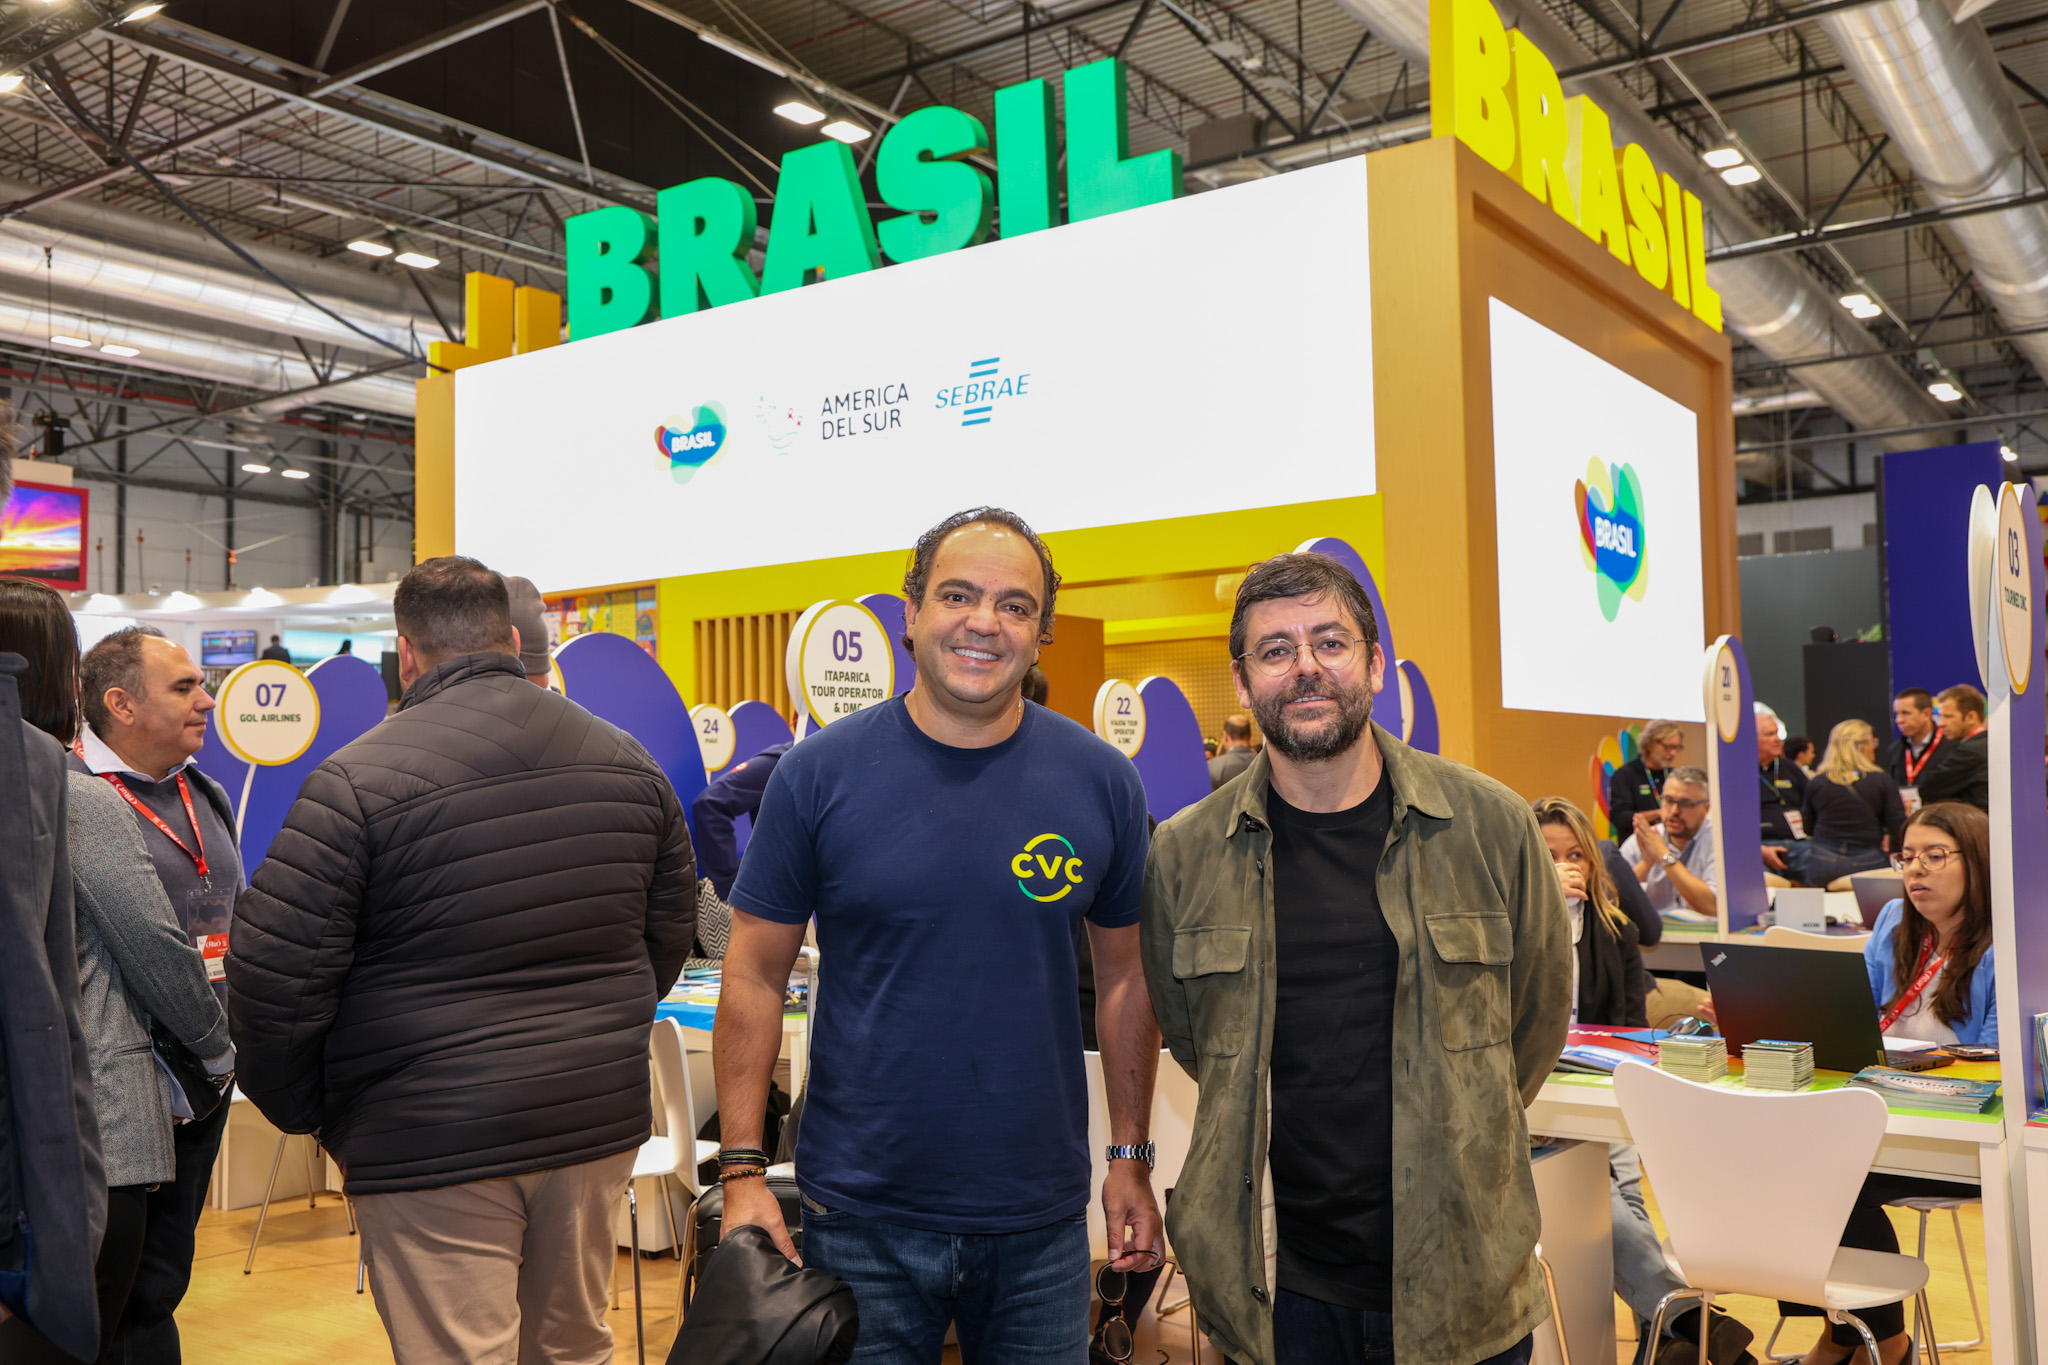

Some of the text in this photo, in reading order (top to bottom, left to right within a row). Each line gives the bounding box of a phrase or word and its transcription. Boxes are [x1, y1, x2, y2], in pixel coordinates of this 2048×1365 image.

[1430, 0, 1723, 334] BRASIL
[565, 56, 1184, 343] BRASIL
[821, 383, 909, 416] AMERICA
[935, 373, 1031, 409] SEBRAE
[822, 408, 902, 440] DEL SUR
[671, 431, 716, 453] BRASIL
[1594, 516, 1638, 558] BRASIL
[2008, 527, 2020, 578] 03
[832, 629, 863, 662] 05
[811, 685, 884, 699] TOUR OPERATOR
[824, 670, 870, 683] ITAPARICA
[255, 683, 287, 707] 07
[833, 702, 840, 713] &
[1117, 696, 1131, 715] 22
[240, 713, 302, 722] GOL AIRLINES
[703, 718, 719, 734] 24
[1010, 852, 1084, 884] CVC
